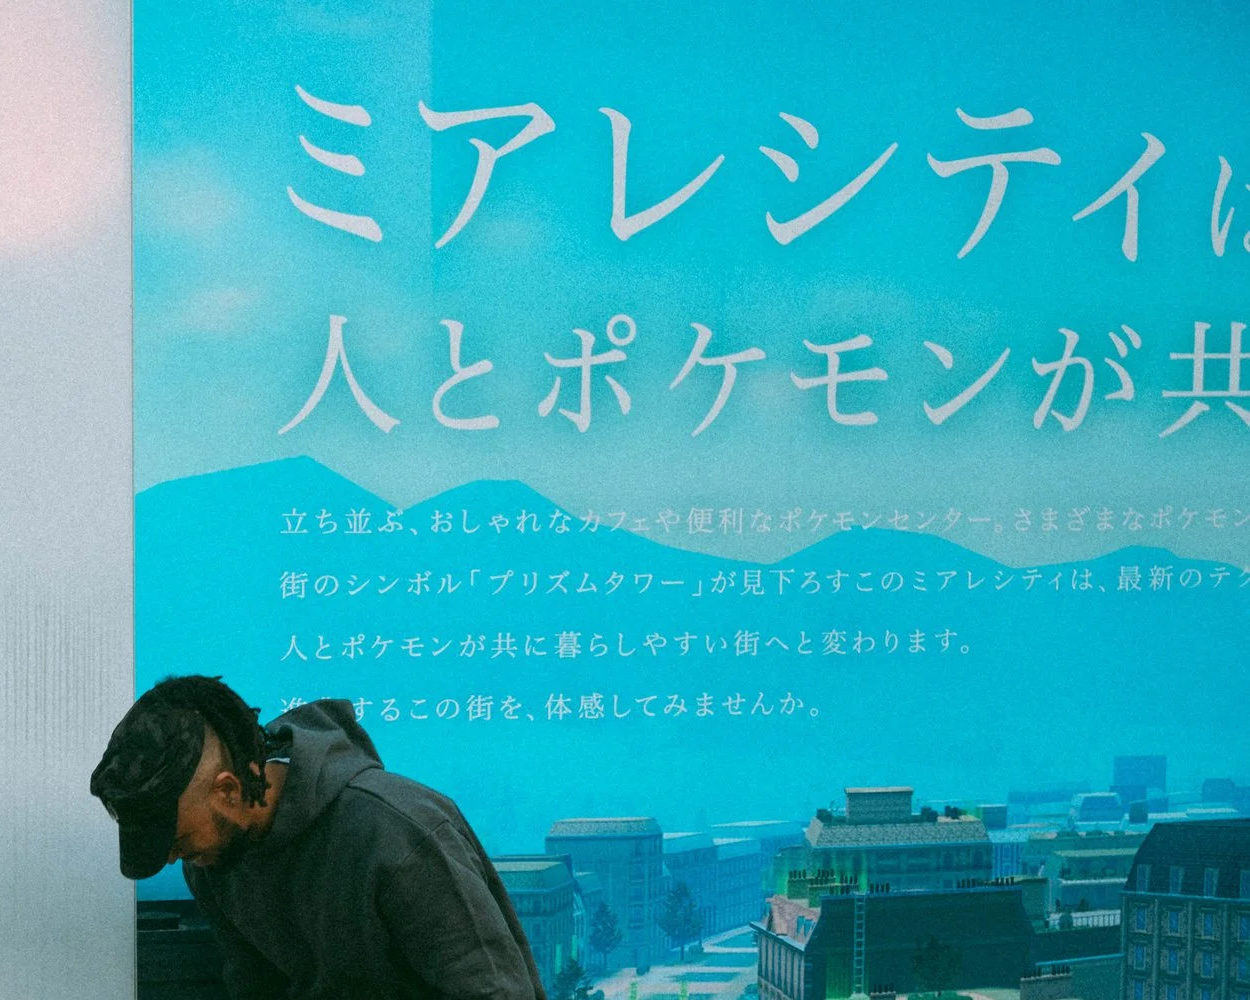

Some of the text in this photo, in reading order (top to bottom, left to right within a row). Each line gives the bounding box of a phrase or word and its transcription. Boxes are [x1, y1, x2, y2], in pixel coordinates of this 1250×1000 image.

[277, 312, 1250, 438] 人とポケモンが共
[280, 628, 971, 661] 人とポケモンが共に暮らしやすい街へと変わります。
[280, 692, 820, 721] するこの街を、体感してみませんか。
